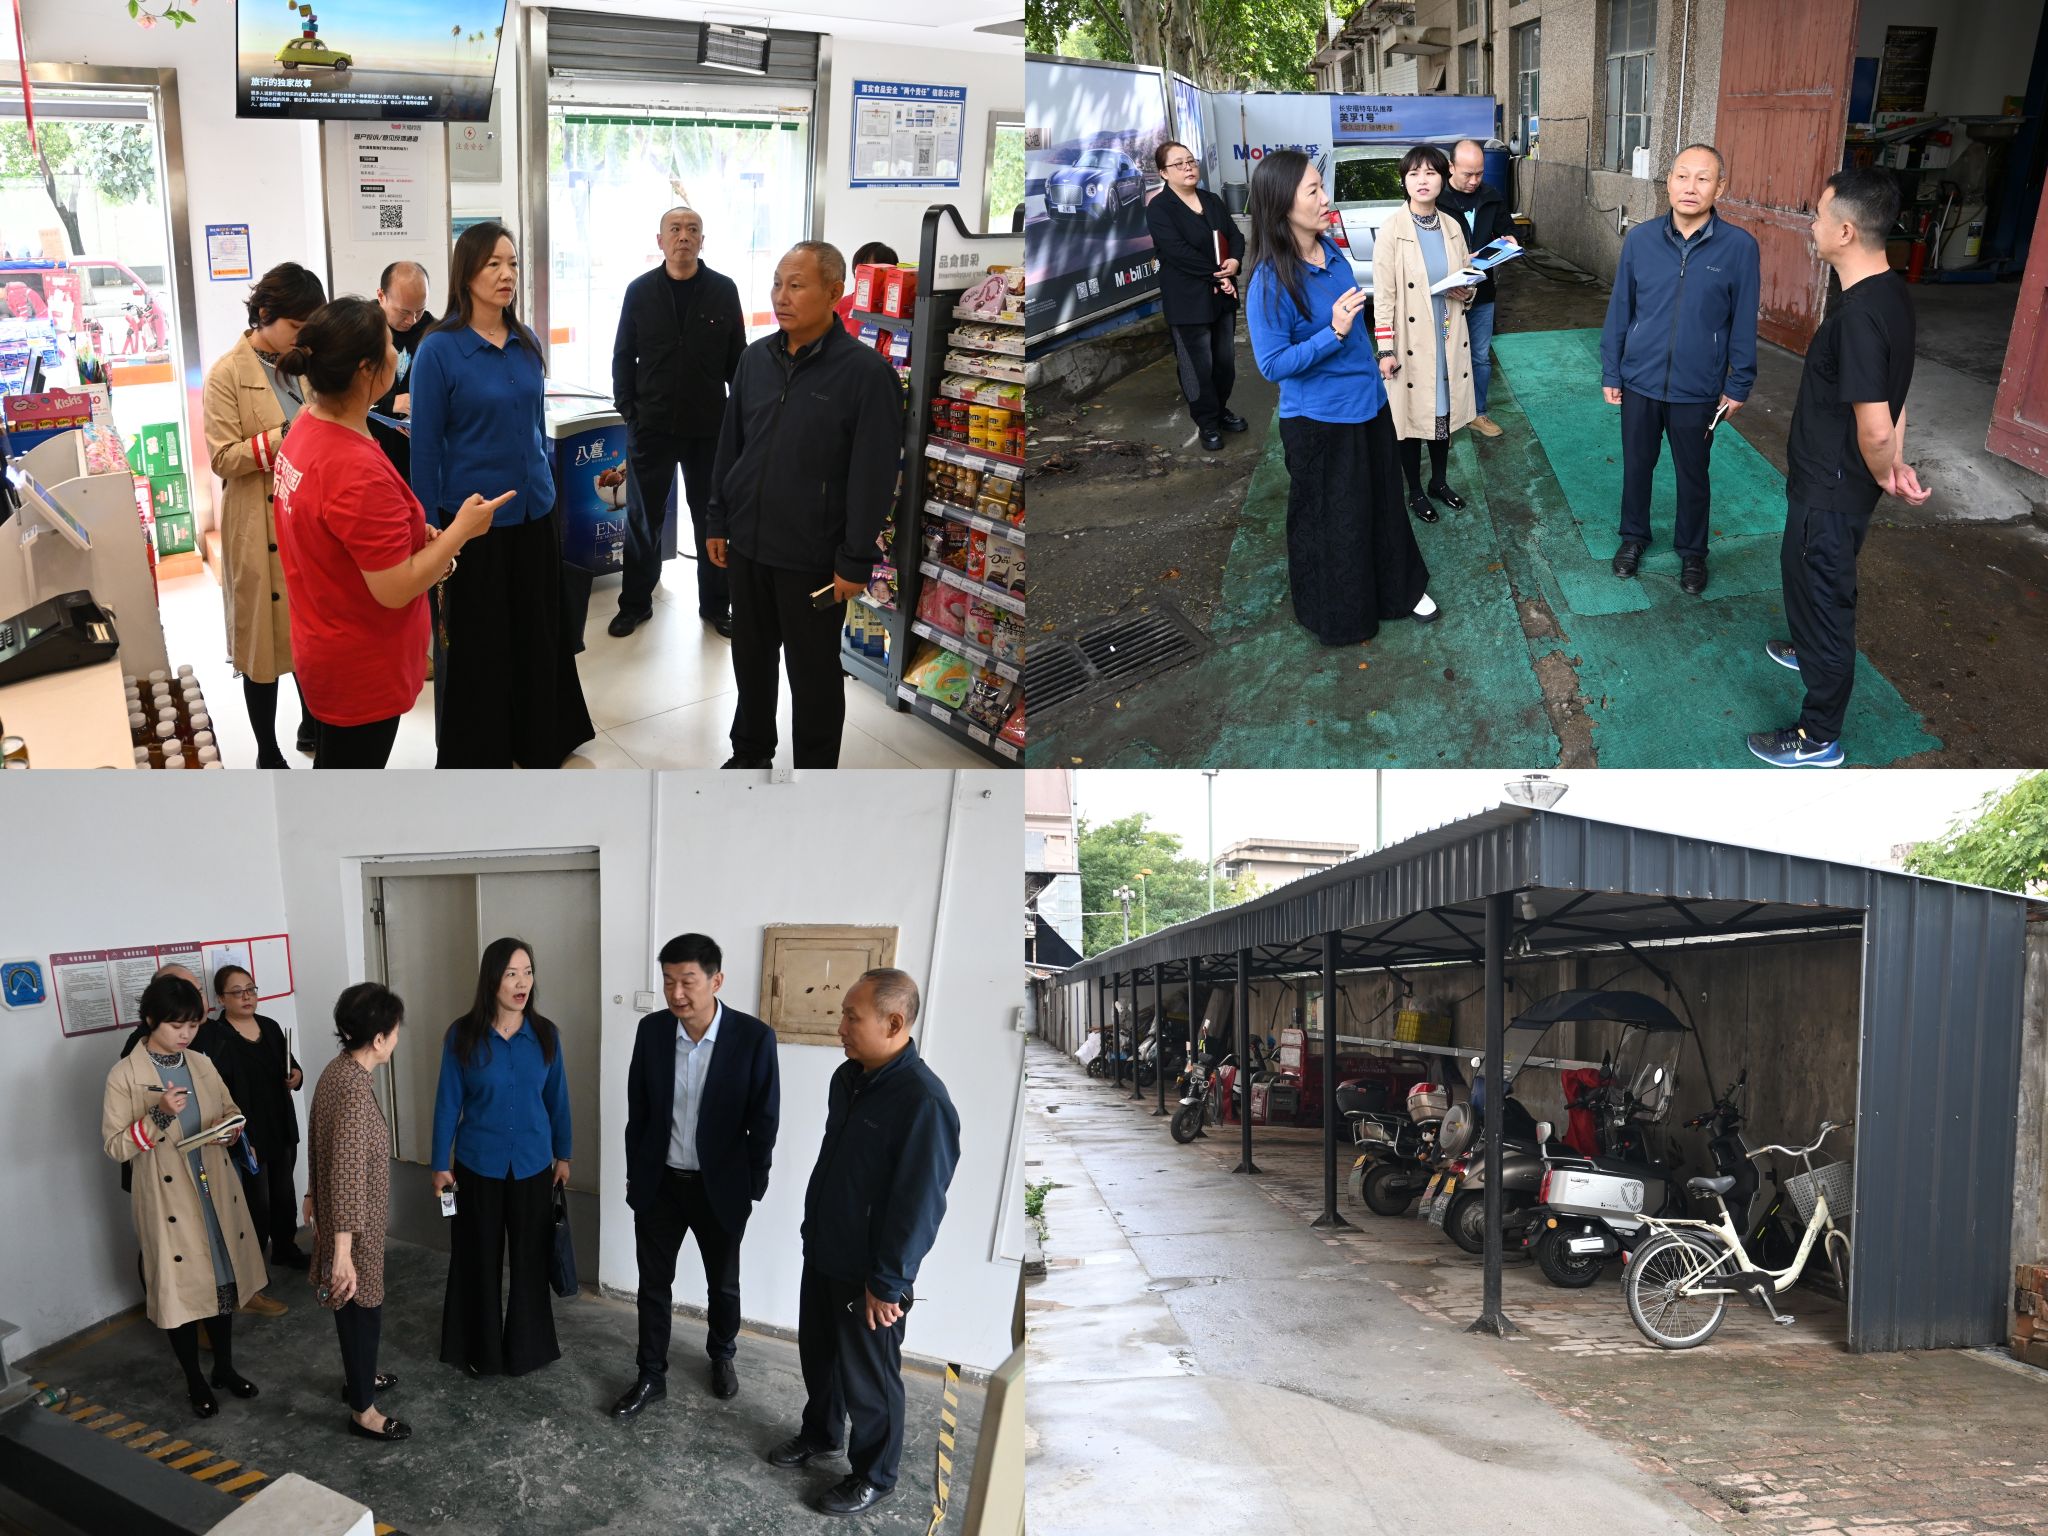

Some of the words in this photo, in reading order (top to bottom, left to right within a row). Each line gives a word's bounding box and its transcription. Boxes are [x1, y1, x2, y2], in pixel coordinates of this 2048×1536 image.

[251, 77, 312, 88] 旅行的独家故事
[1339, 104, 1393, 113] 长安福特车队推荐
[1340, 112, 1375, 123] 美孚1号
[1114, 264, 1142, 288] Mobil
[595, 518, 625, 537] ENJ
